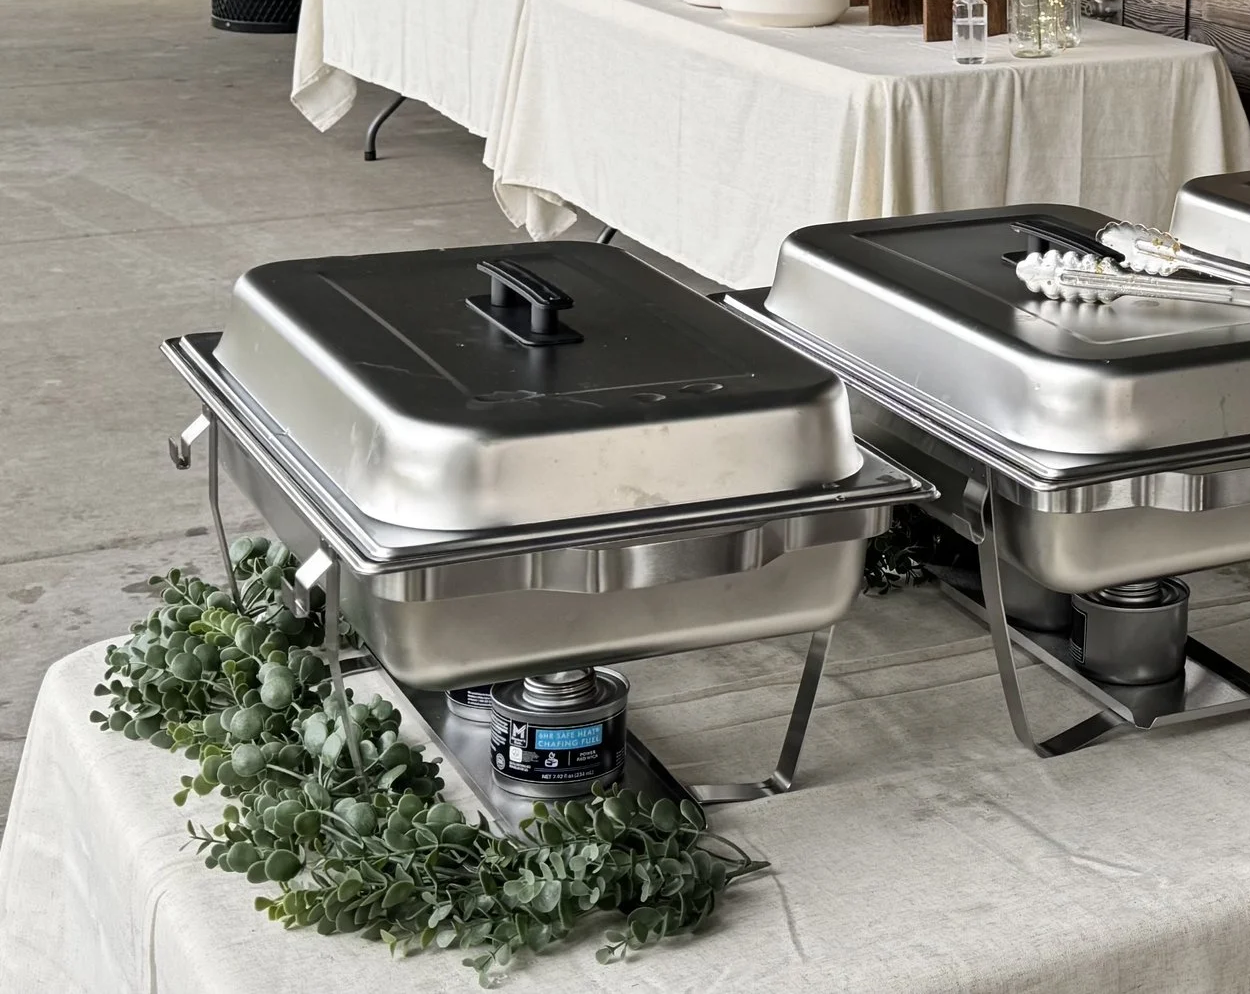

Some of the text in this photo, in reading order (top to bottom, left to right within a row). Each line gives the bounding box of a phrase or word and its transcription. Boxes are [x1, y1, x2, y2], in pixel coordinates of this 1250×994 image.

[556, 731, 575, 739] SAFE
[537, 737, 601, 748] CHAFING FUEL
